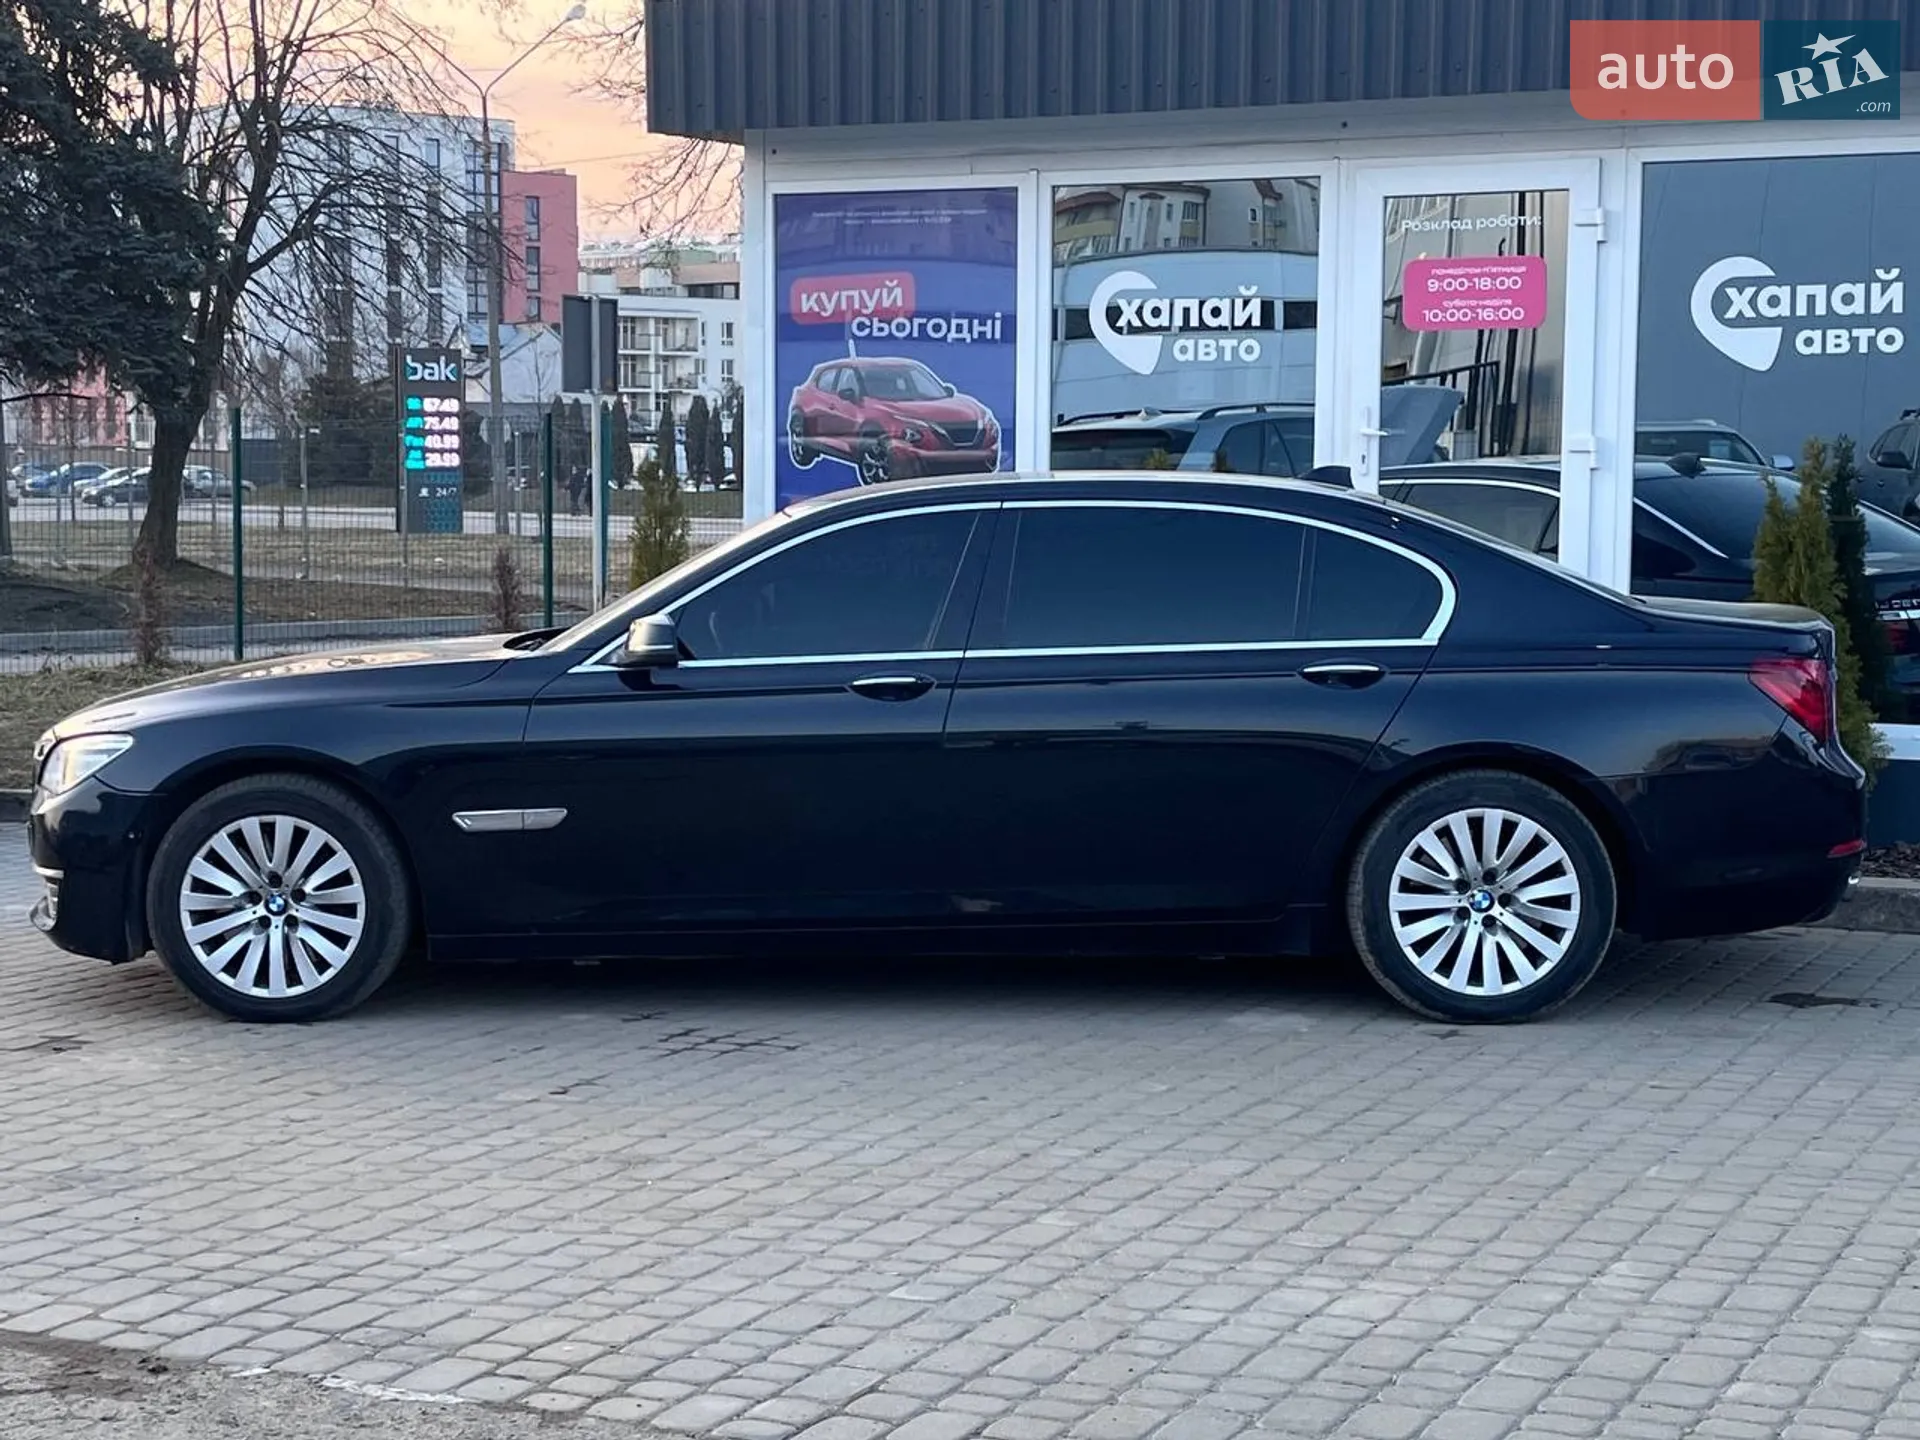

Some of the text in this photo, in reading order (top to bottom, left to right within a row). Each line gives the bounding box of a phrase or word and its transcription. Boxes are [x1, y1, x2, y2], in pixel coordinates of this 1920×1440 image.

[1402, 214, 1542, 233] Розклад роботи:
[801, 279, 903, 316] купуй
[1427, 276, 1522, 292] 9:00-18:00
[1723, 268, 1904, 319] хапай
[1115, 285, 1261, 328] хапай
[1422, 307, 1524, 323] 10:00-16:00
[851, 312, 1002, 343] сьогодні
[1795, 327, 1905, 355] авто
[1172, 338, 1261, 362] авто
[406, 355, 457, 381] bak
